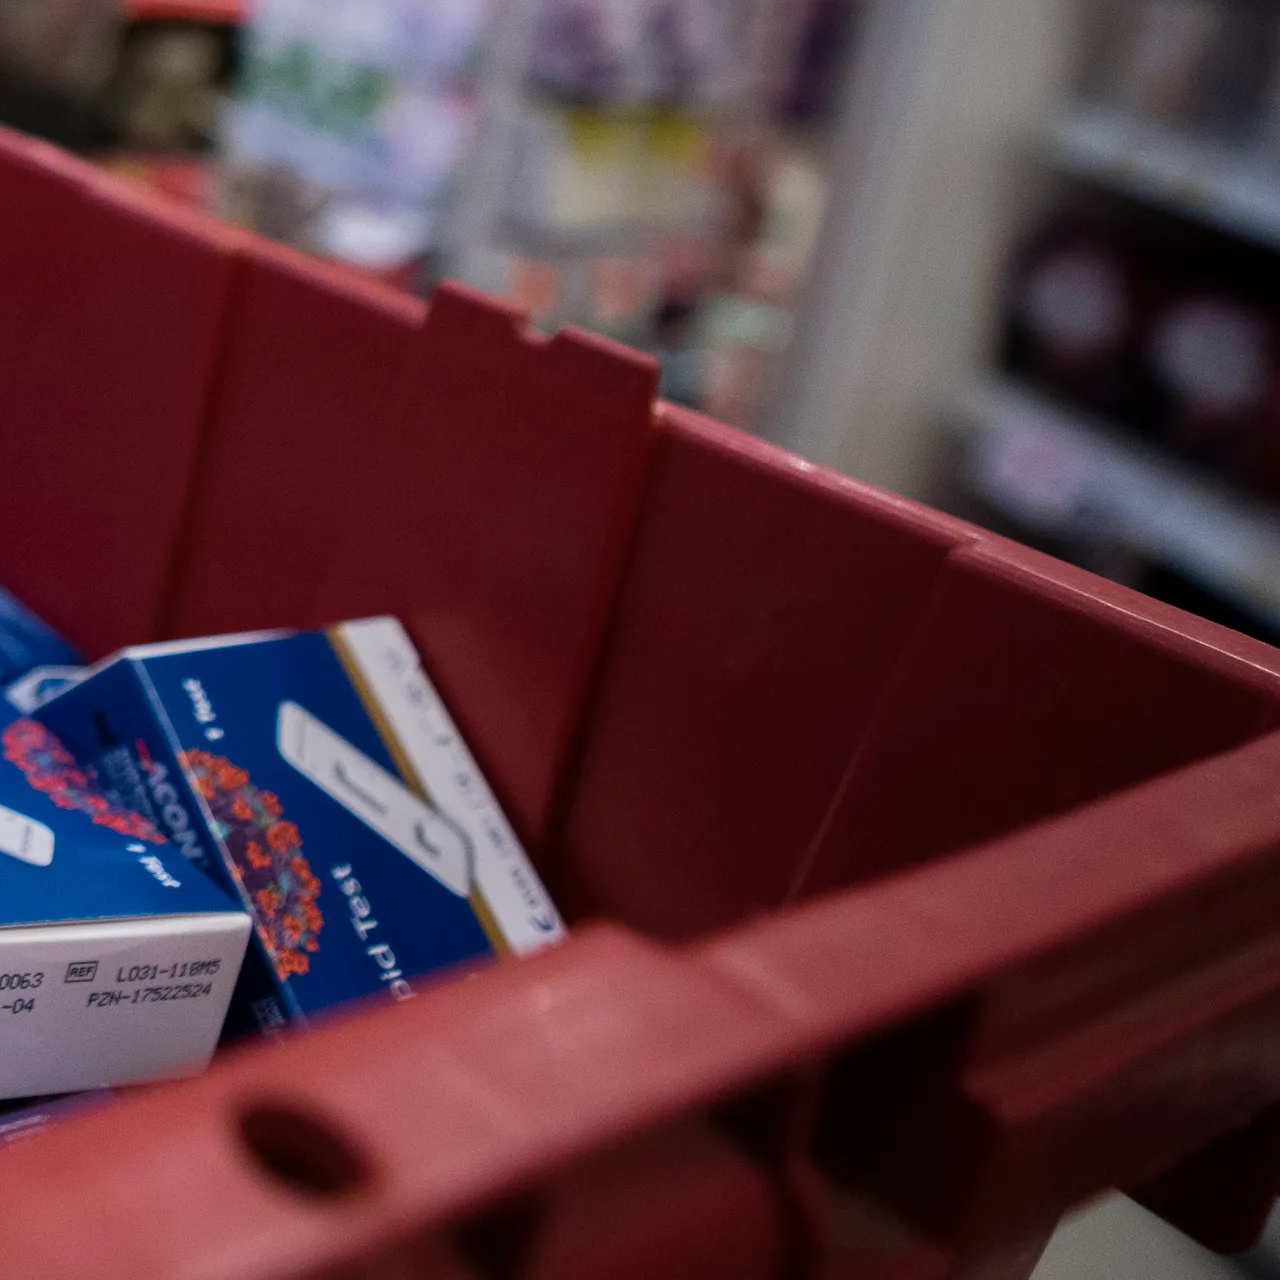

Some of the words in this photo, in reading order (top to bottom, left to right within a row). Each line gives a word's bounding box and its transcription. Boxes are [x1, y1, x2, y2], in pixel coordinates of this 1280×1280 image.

[138, 742, 207, 860] ACON
[331, 863, 379, 942] Test
[87, 984, 213, 1008] PZN-17522524
[368, 943, 416, 1001] pid
